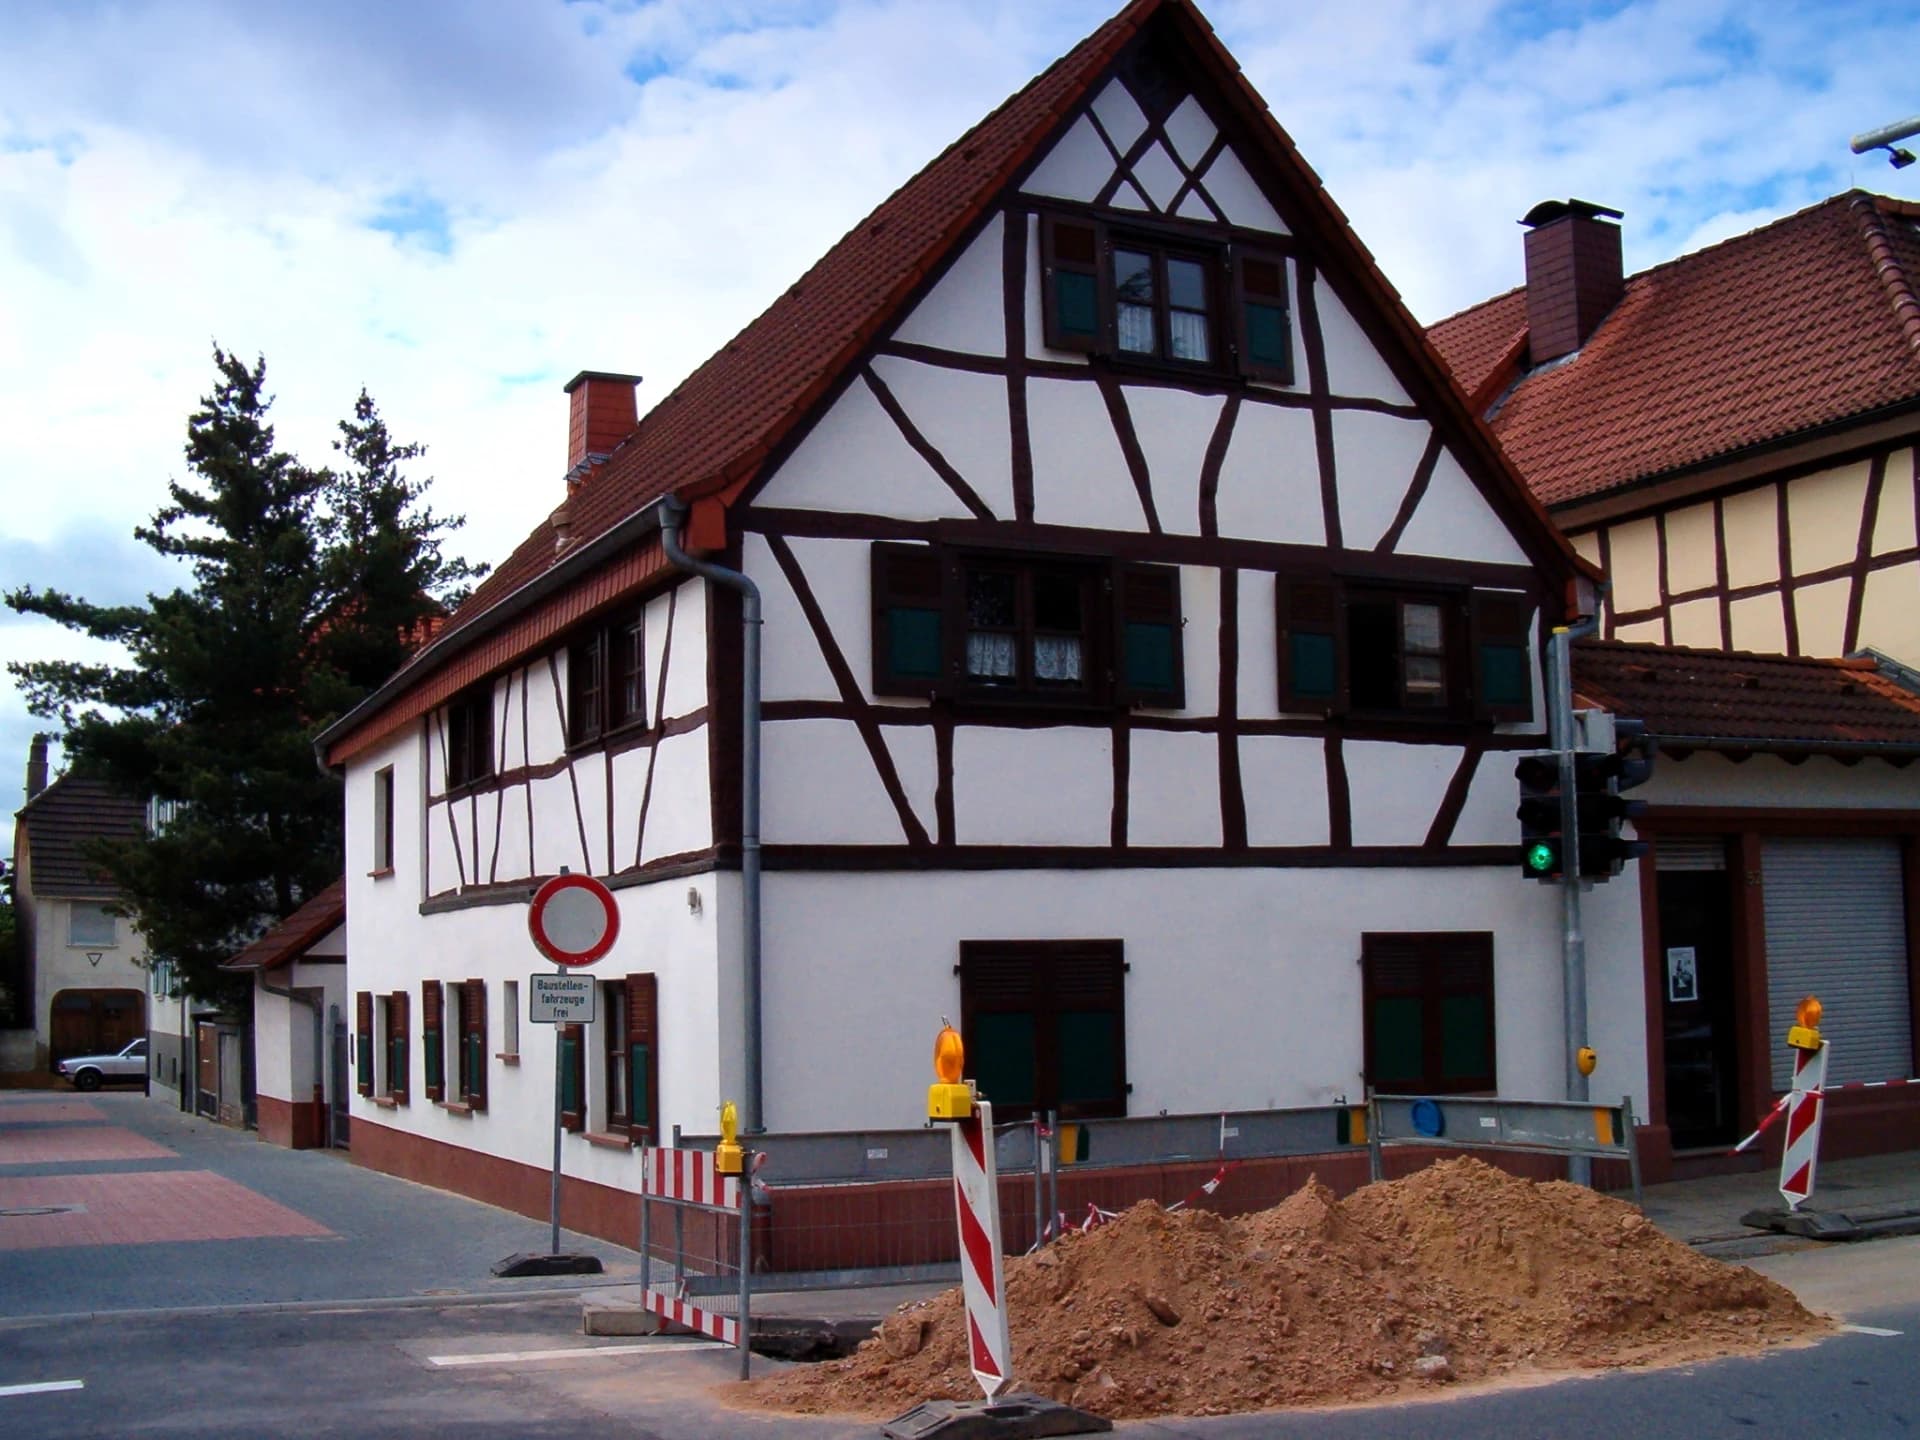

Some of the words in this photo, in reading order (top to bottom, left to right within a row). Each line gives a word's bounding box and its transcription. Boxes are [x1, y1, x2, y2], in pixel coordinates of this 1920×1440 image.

[537, 979, 589, 990] Baustellen-
[541, 993, 585, 1006] fahrzeuge
[553, 1007, 569, 1018] frei
